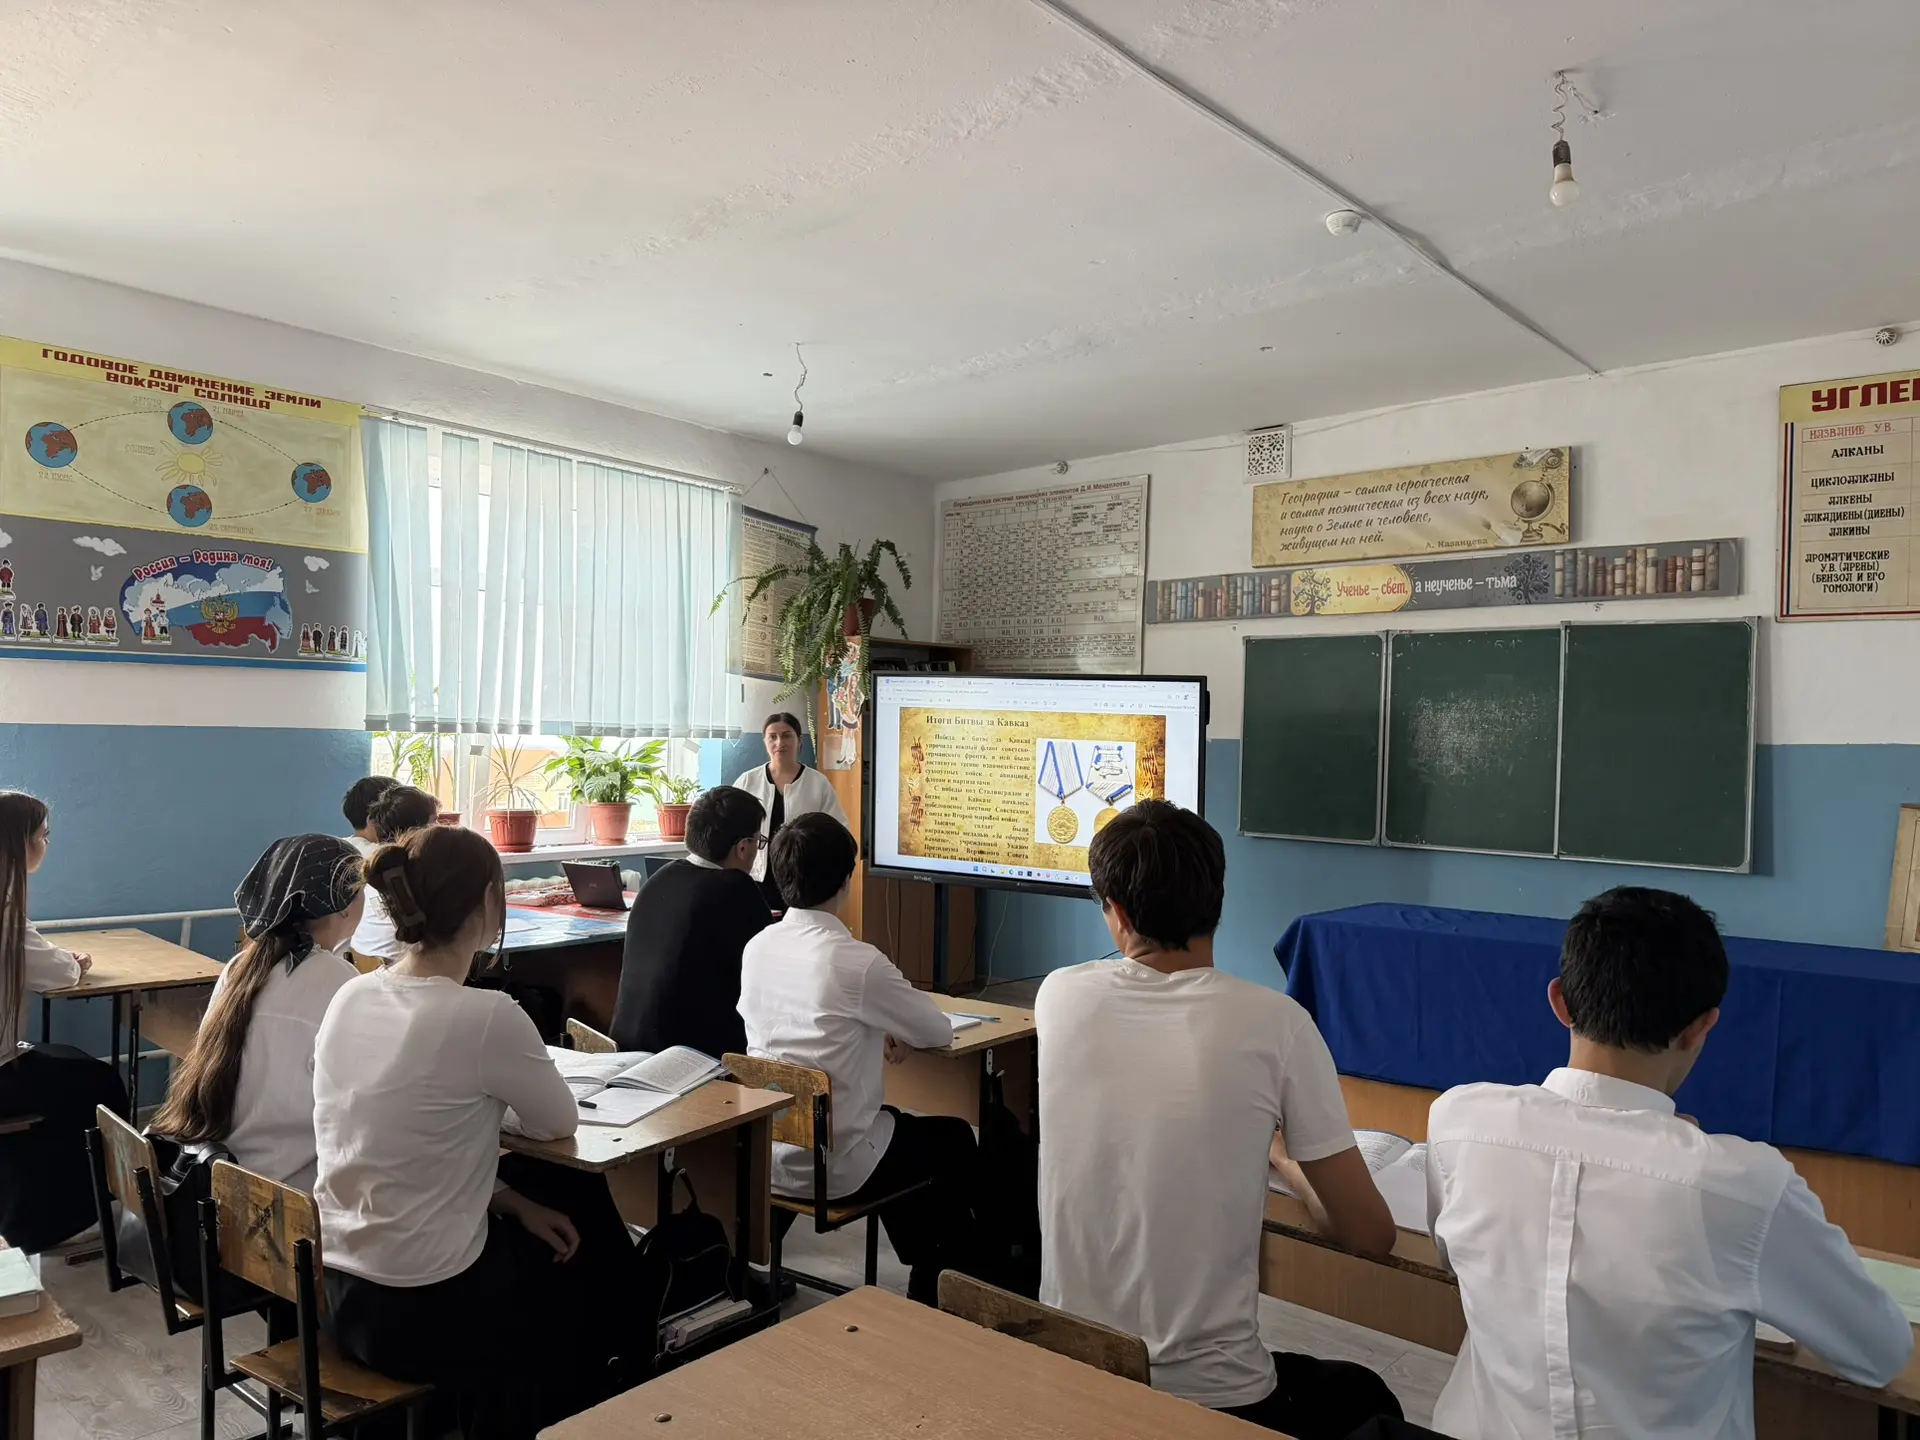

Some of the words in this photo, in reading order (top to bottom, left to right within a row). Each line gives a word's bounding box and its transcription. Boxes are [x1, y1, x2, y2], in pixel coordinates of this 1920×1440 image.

[42, 348, 139, 375] ГОДОВОЕ
[148, 369, 255, 397] ДВИЖЕНИЕ
[264, 390, 321, 409] ЗЕМЛИ
[106, 371, 183, 393] ВОКРУГ
[194, 388, 271, 410] СОЛНЦА
[1809, 425, 1866, 440] НАЗВАНИЕ
[1831, 445, 1884, 458] АЛКАНЫ
[1811, 472, 1895, 489] ЦИКЛОАЛКАНЫ
[1281, 489, 1340, 506] География
[1355, 483, 1392, 496] самая
[1396, 474, 1470, 495] героическая
[1281, 511, 1287, 520] и
[1290, 507, 1324, 519] самая
[1328, 498, 1403, 515] поэтическая
[1407, 496, 1421, 511] из
[1423, 490, 1451, 504] всех
[1454, 489, 1489, 505] наук,
[1828, 493, 1873, 506] АЛКЕНЫ
[1280, 523, 1313, 539] наука
[1316, 523, 1323, 532] о
[1326, 519, 1361, 531] Земле
[1365, 517, 1373, 527] и
[1377, 509, 1432, 527] человеке,
[1828, 525, 1870, 537] АЛКИНЫ
[1280, 536, 1338, 554] живущем
[1341, 536, 1356, 546] на
[1359, 531, 1384, 544] ней.
[1438, 537, 1488, 548] Казанцева
[1805, 549, 1890, 563] АРОМАТИЧЕСКИЕ
[133, 556, 177, 580] Россия
[193, 550, 238, 565] Родина
[243, 554, 273, 570] моя!
[1839, 560, 1880, 572] (АРЕНЫ)
[1812, 572, 1852, 584] (БЕНЗОЛ
[1856, 572, 1863, 582] И
[1867, 571, 1886, 582] ЕГО
[1336, 580, 1370, 597] Ученье
[1381, 578, 1408, 595] свет,
[1415, 582, 1422, 593] а
[1424, 577, 1473, 595] неученье
[1823, 581, 1879, 593] ГОМОЛОГИ)
[926, 715, 952, 725] Итоги
[954, 716, 983, 726] Битвы
[997, 717, 1030, 728] Кавказ
[952, 812, 973, 820] Второй
[924, 844, 959, 853] Президиума
[1007, 851, 1029, 860] Совета
